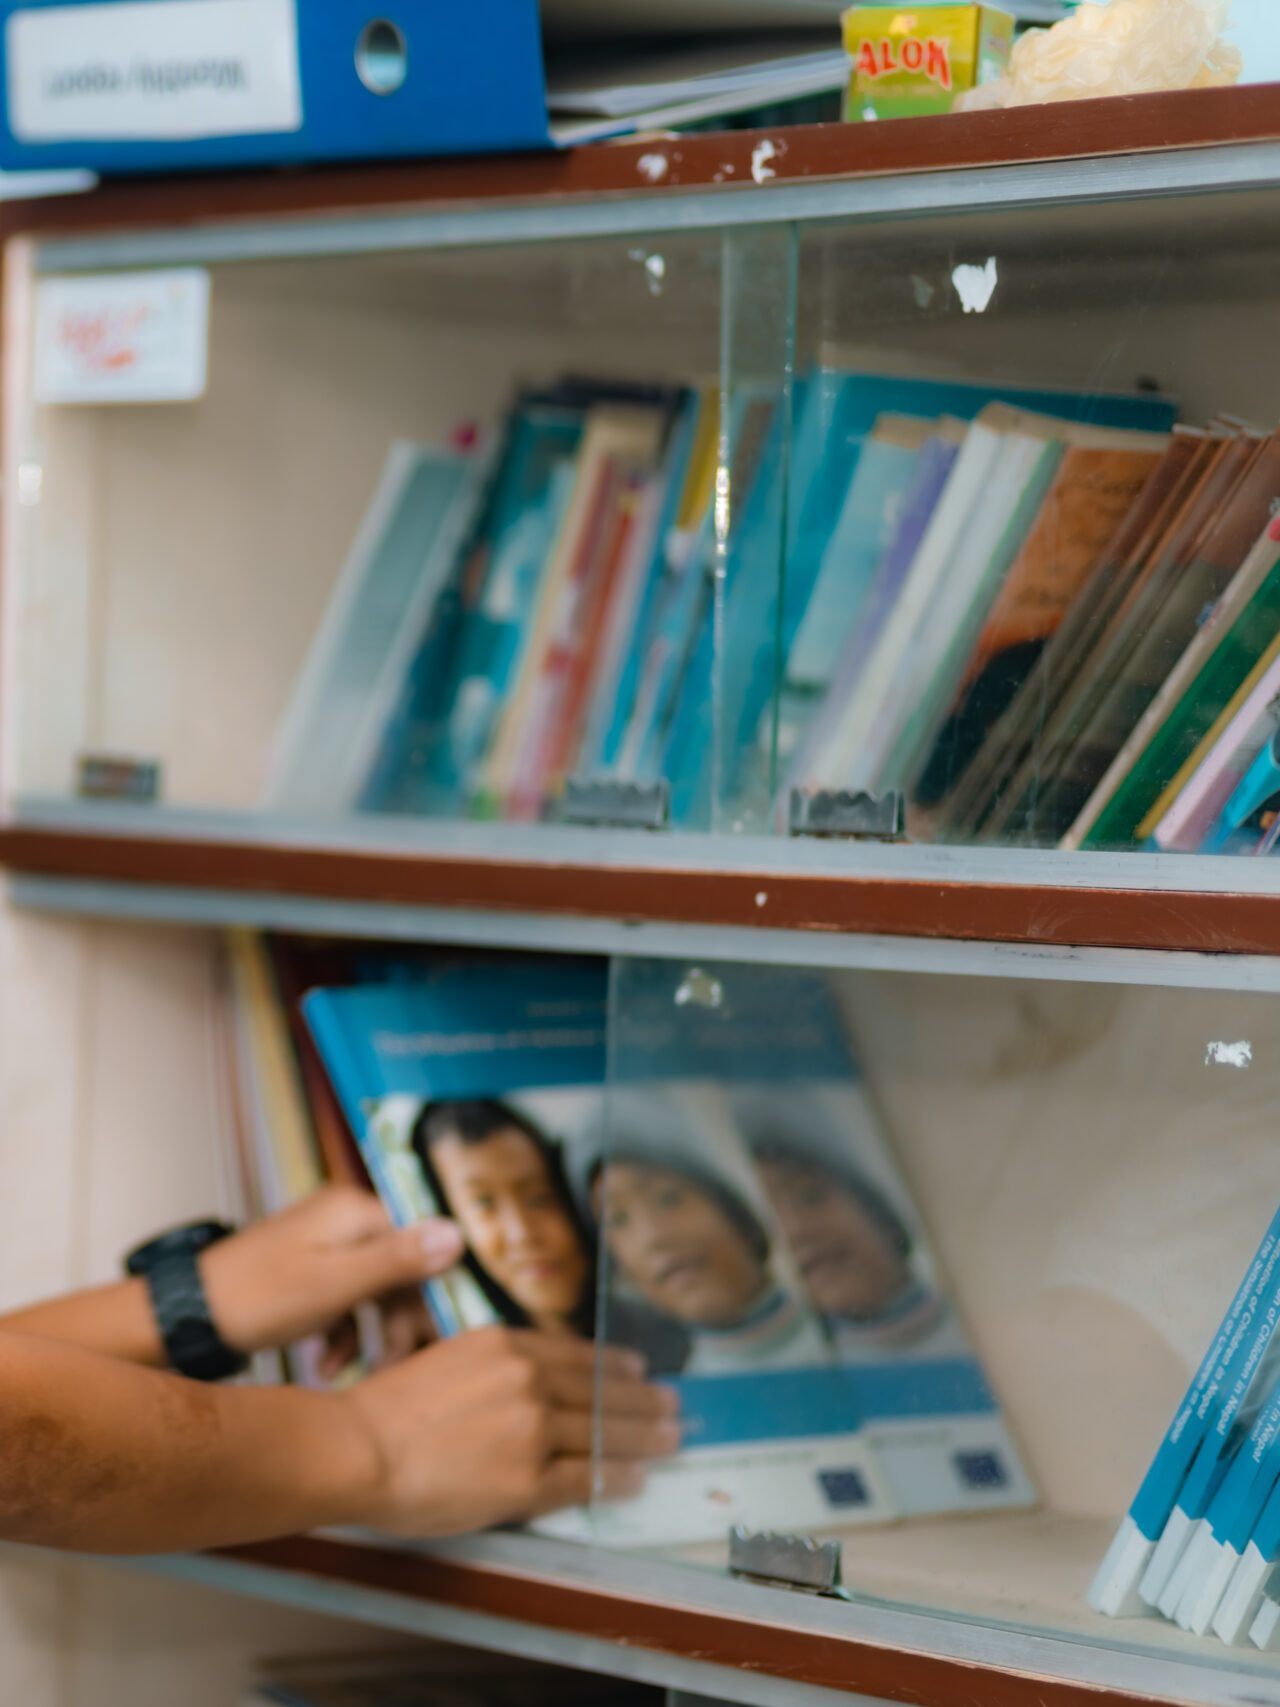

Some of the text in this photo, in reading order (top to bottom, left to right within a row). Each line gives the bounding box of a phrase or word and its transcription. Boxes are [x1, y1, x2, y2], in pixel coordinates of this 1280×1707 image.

[1248, 1296, 1257, 1313] of
[1266, 1307, 1276, 1325] of
[1222, 1311, 1252, 1366] Children
[1240, 1323, 1270, 1379] Children
[1197, 1381, 1218, 1419] Nepal
[1234, 1380, 1245, 1394] in
[1216, 1395, 1238, 1435] Nepal
[1253, 1423, 1274, 1463] Nepal
